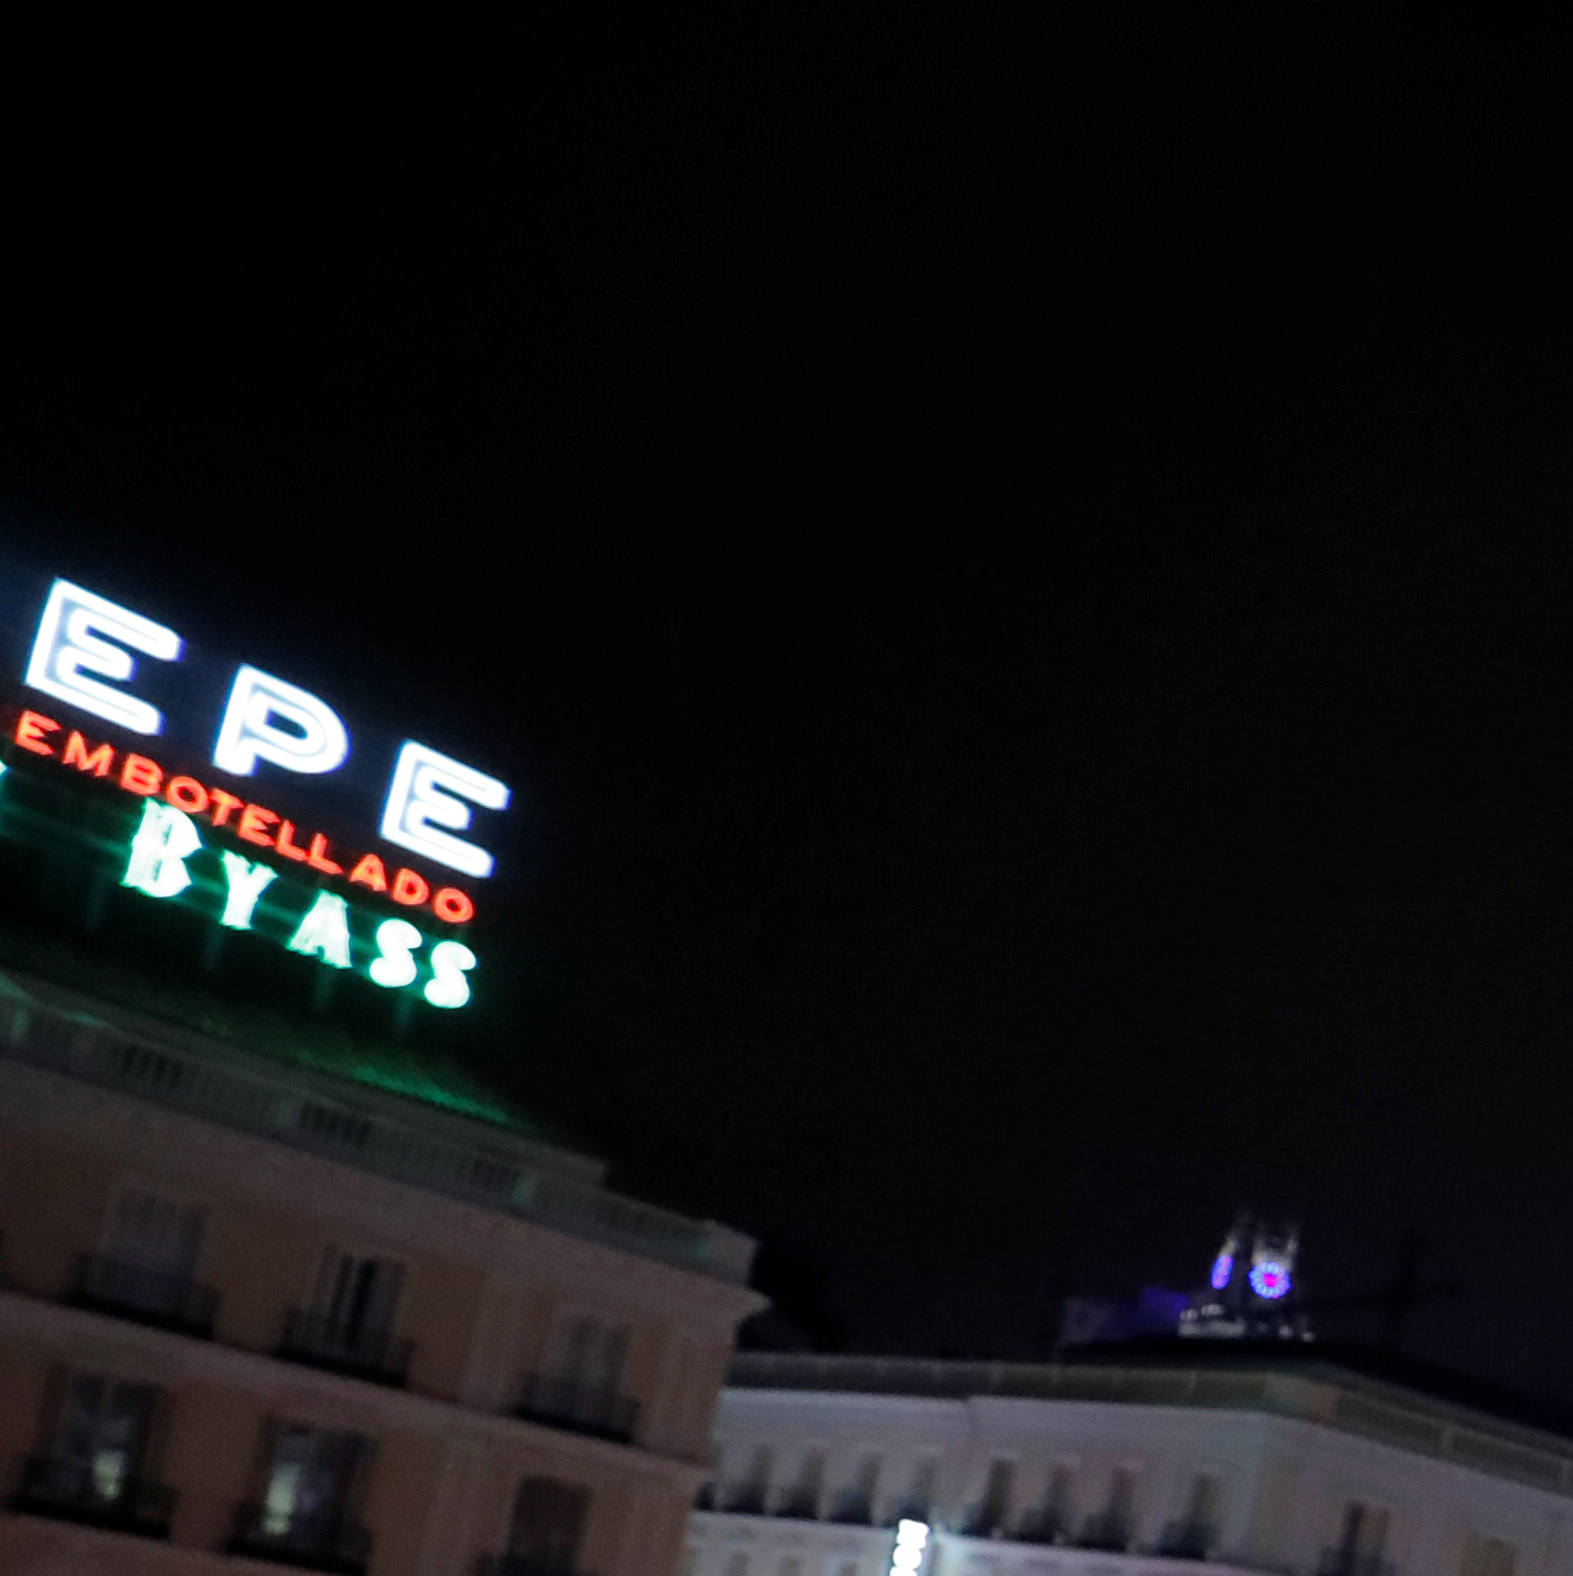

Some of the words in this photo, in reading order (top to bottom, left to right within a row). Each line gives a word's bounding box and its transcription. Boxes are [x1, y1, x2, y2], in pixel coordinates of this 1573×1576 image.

[14, 709, 476, 924] EMBOTELLADO
[24, 578, 512, 878] EPE
[120, 796, 477, 1009] BYASS
